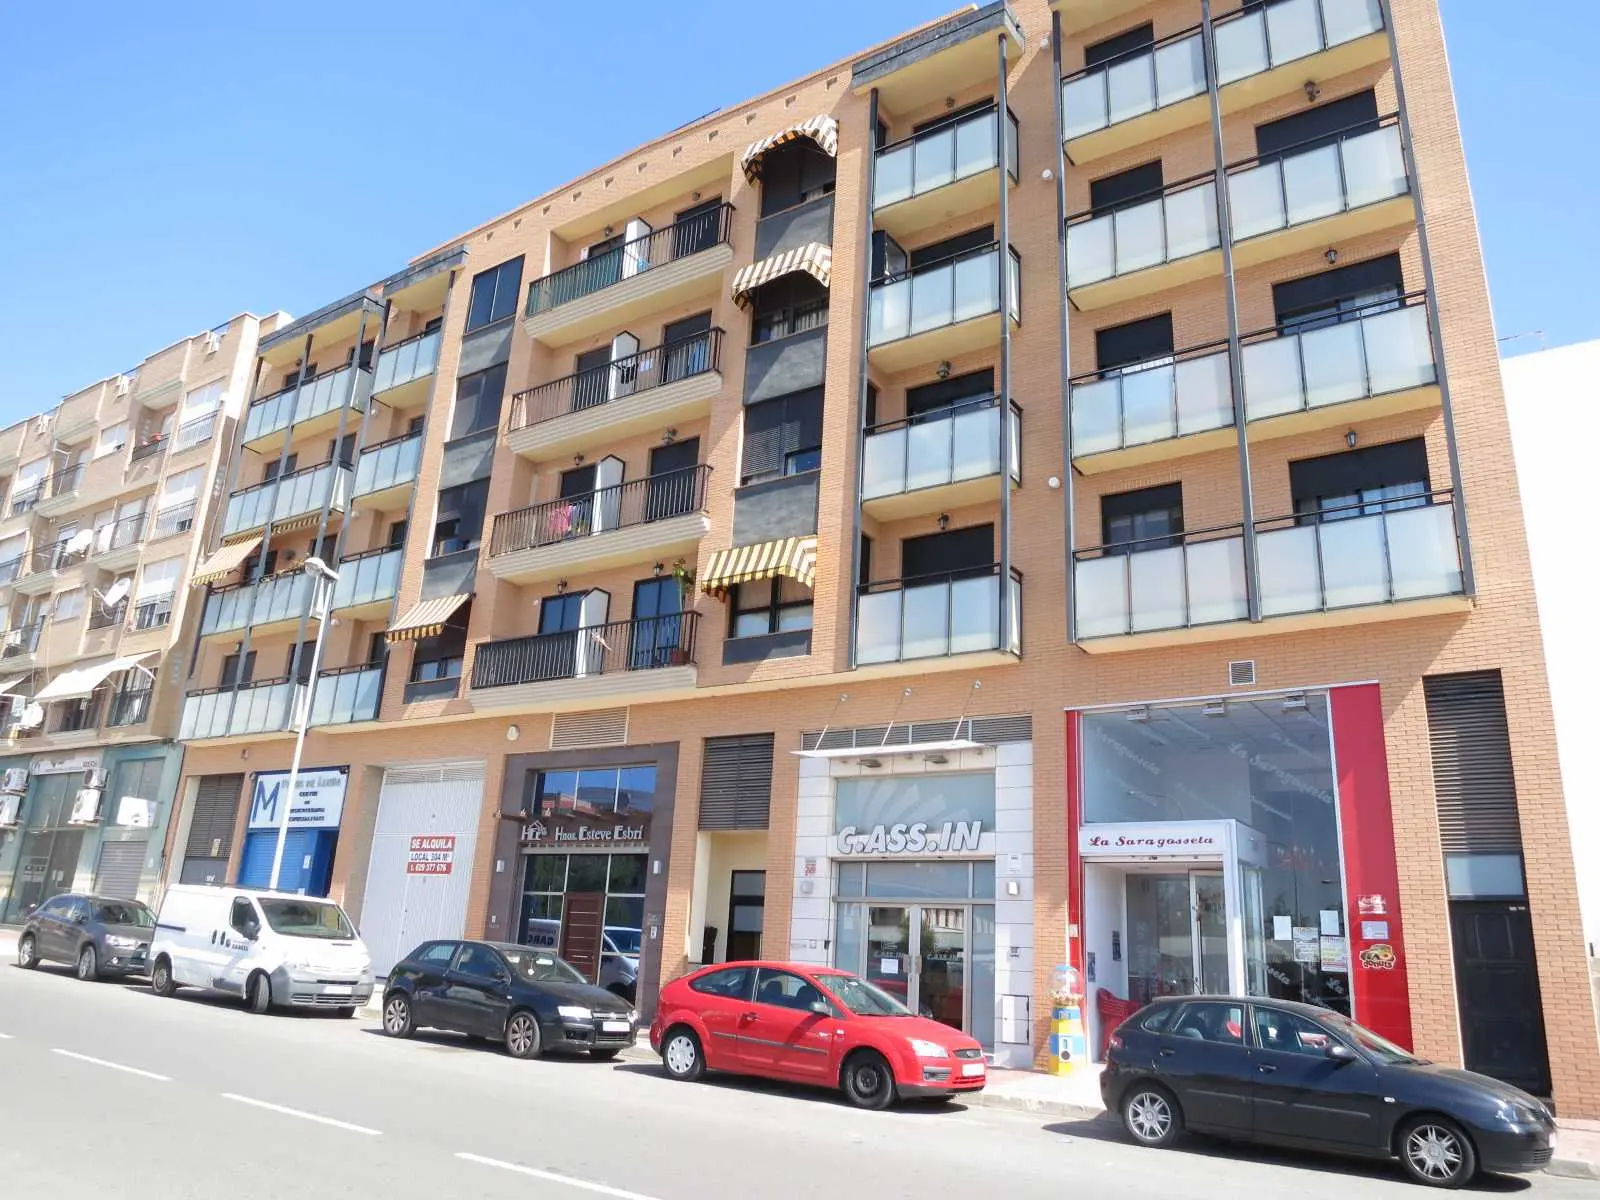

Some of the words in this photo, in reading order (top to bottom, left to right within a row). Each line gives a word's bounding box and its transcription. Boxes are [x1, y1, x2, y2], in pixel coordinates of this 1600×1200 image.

[579, 826, 611, 840] Esteve
[411, 839, 421, 849] SE
[421, 838, 453, 849] ALQUILA
[1090, 836, 1110, 846] La
[410, 852, 429, 861] LOCAL
